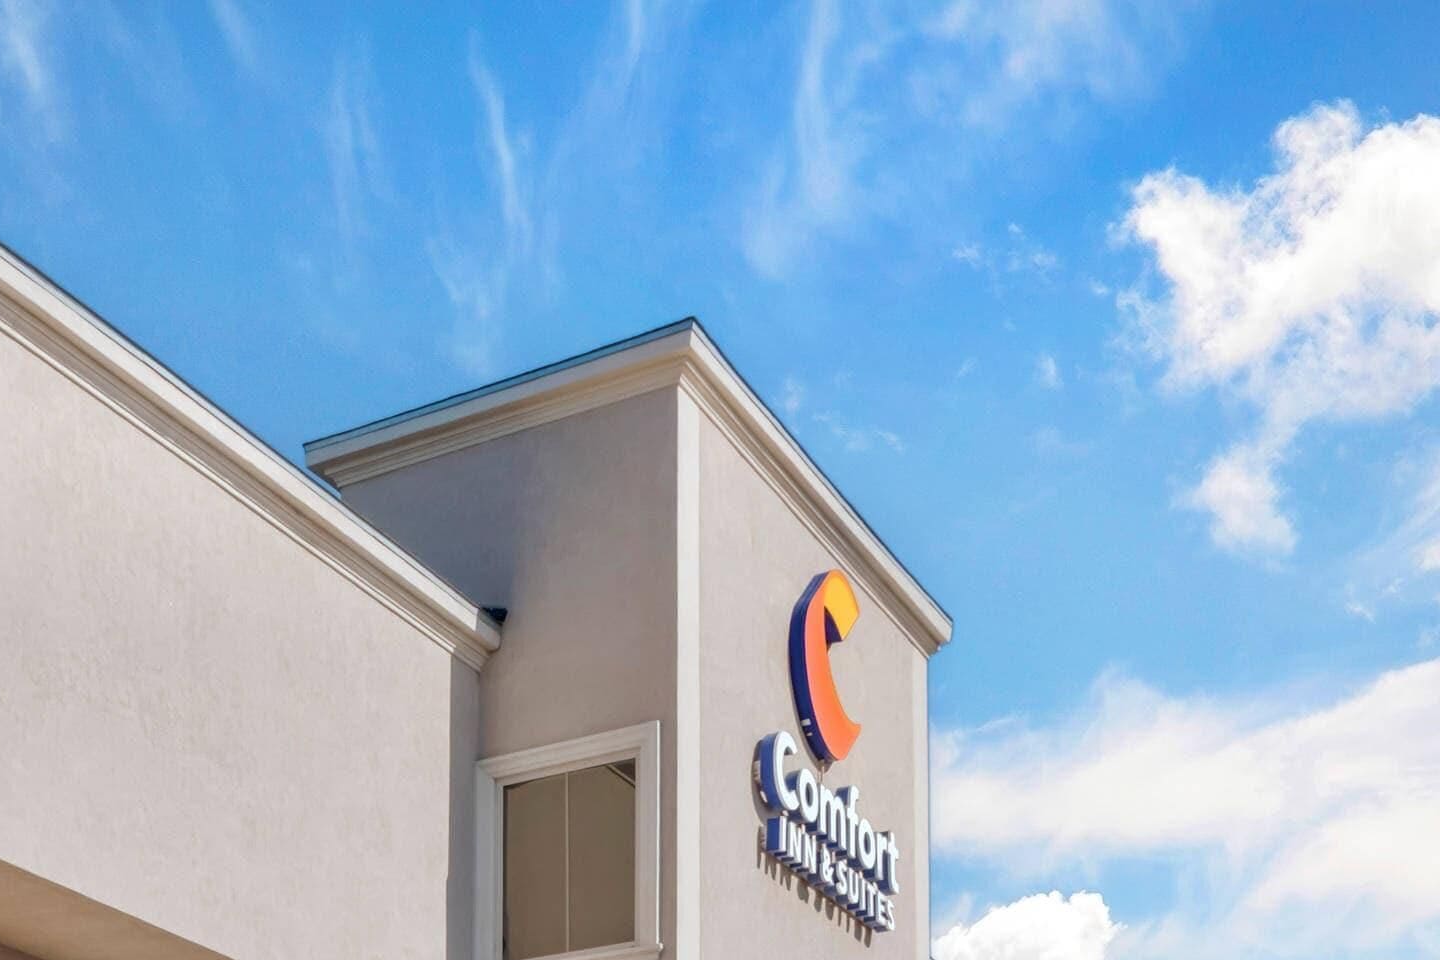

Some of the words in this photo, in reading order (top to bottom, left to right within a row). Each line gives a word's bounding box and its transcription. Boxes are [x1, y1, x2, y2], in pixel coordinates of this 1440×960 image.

[762, 730, 899, 894] Comfort
[768, 815, 817, 877] INN
[835, 859, 895, 932] SUITES
